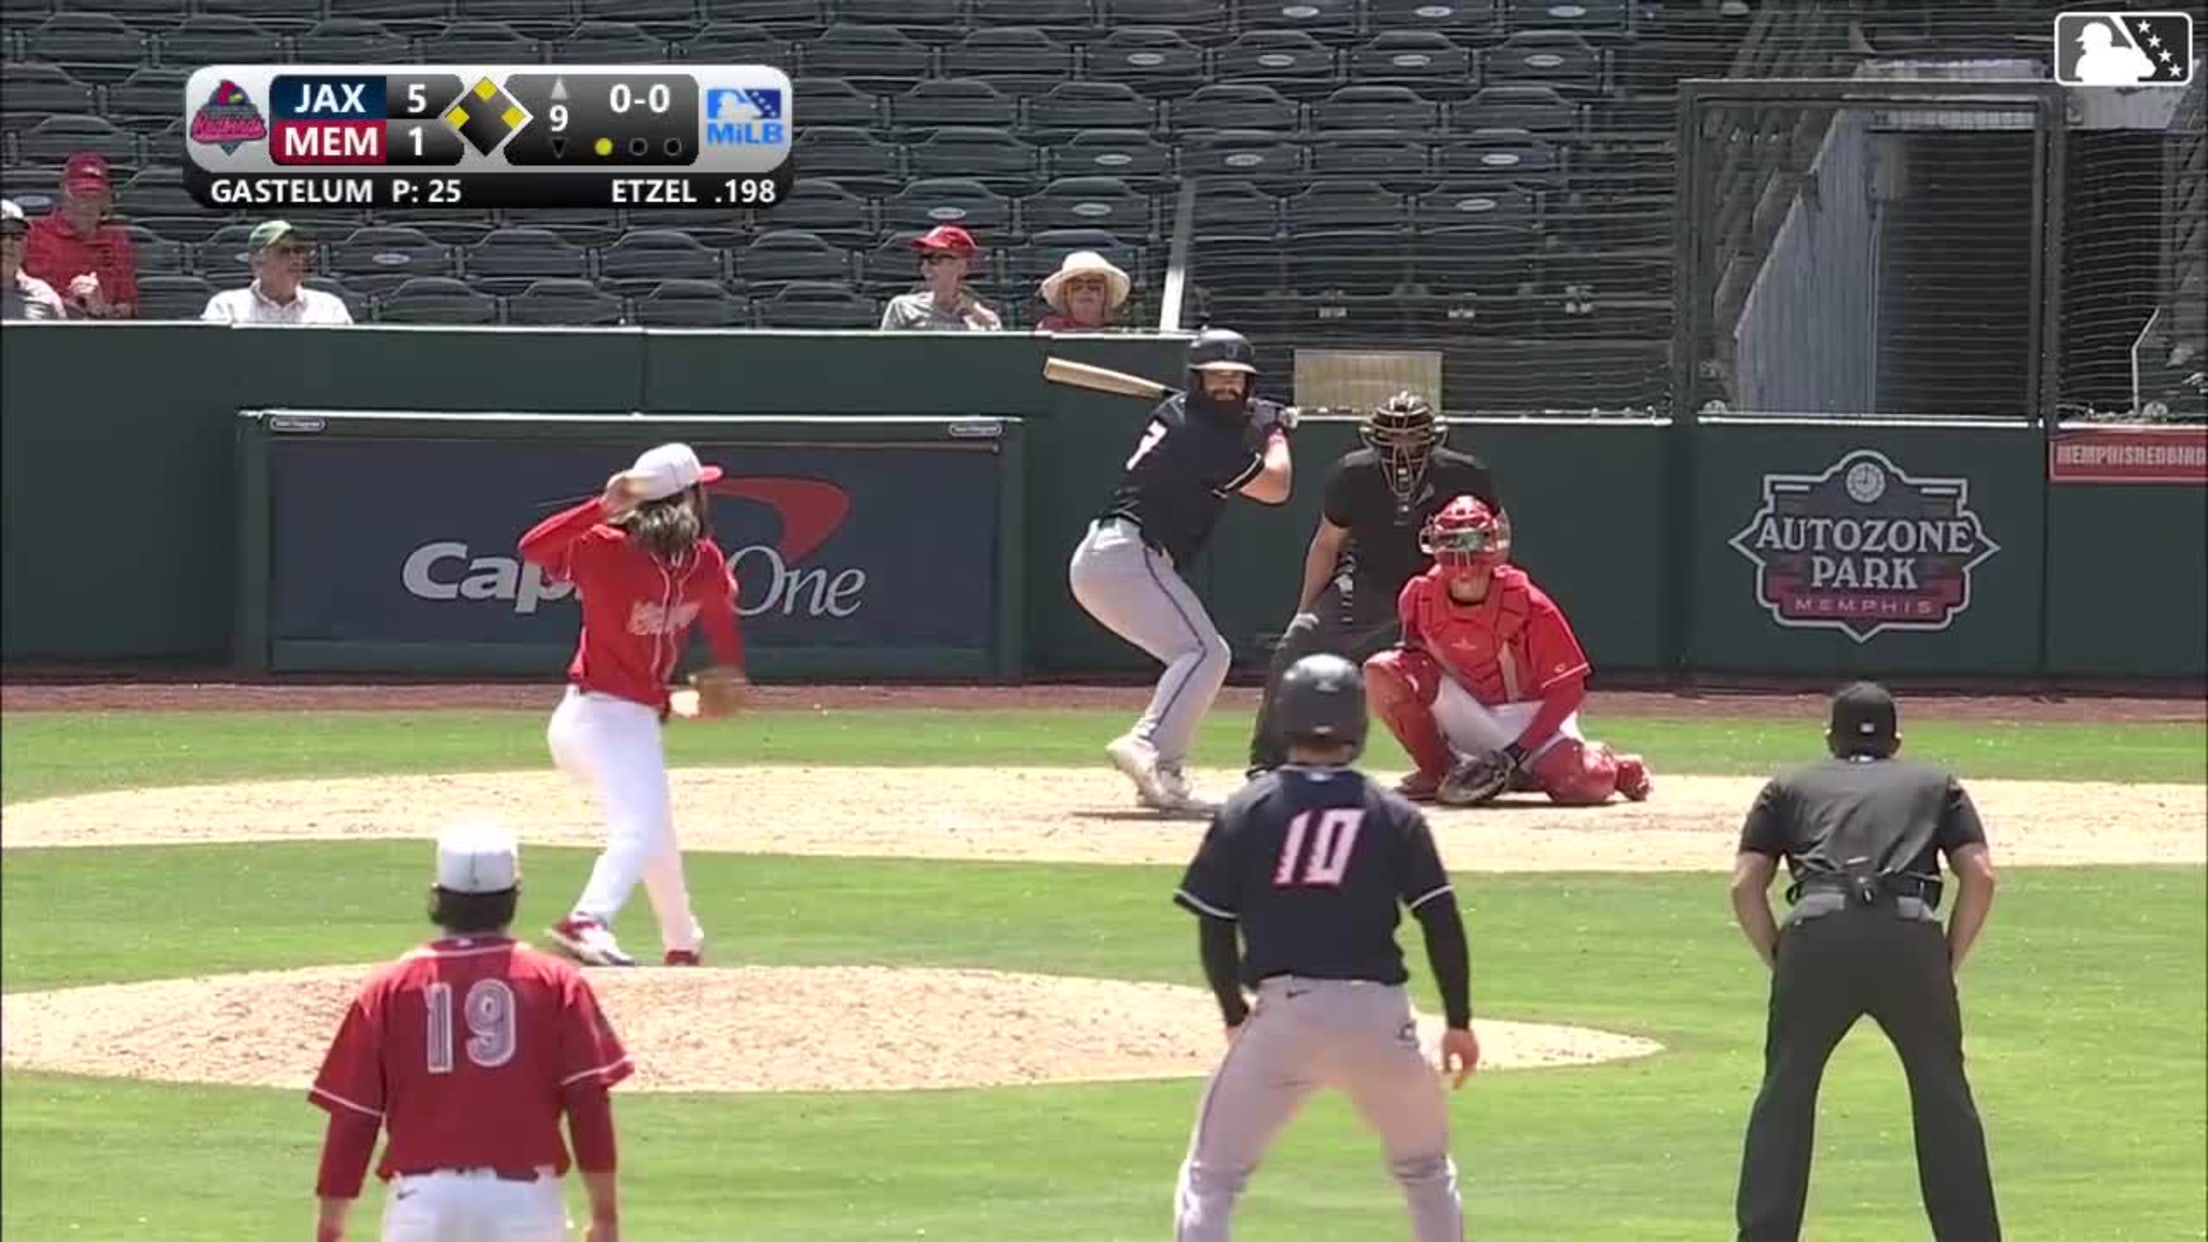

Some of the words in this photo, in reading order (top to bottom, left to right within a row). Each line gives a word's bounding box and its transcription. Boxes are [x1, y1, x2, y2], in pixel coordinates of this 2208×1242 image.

[1755, 517, 1975, 553] AUTOZONE
[729, 545, 867, 617] One
[1811, 556, 1919, 589] PARK
[1794, 598, 1933, 614] MEMPHIS
[1273, 808, 1367, 887] 10
[421, 978, 516, 1074] 19
